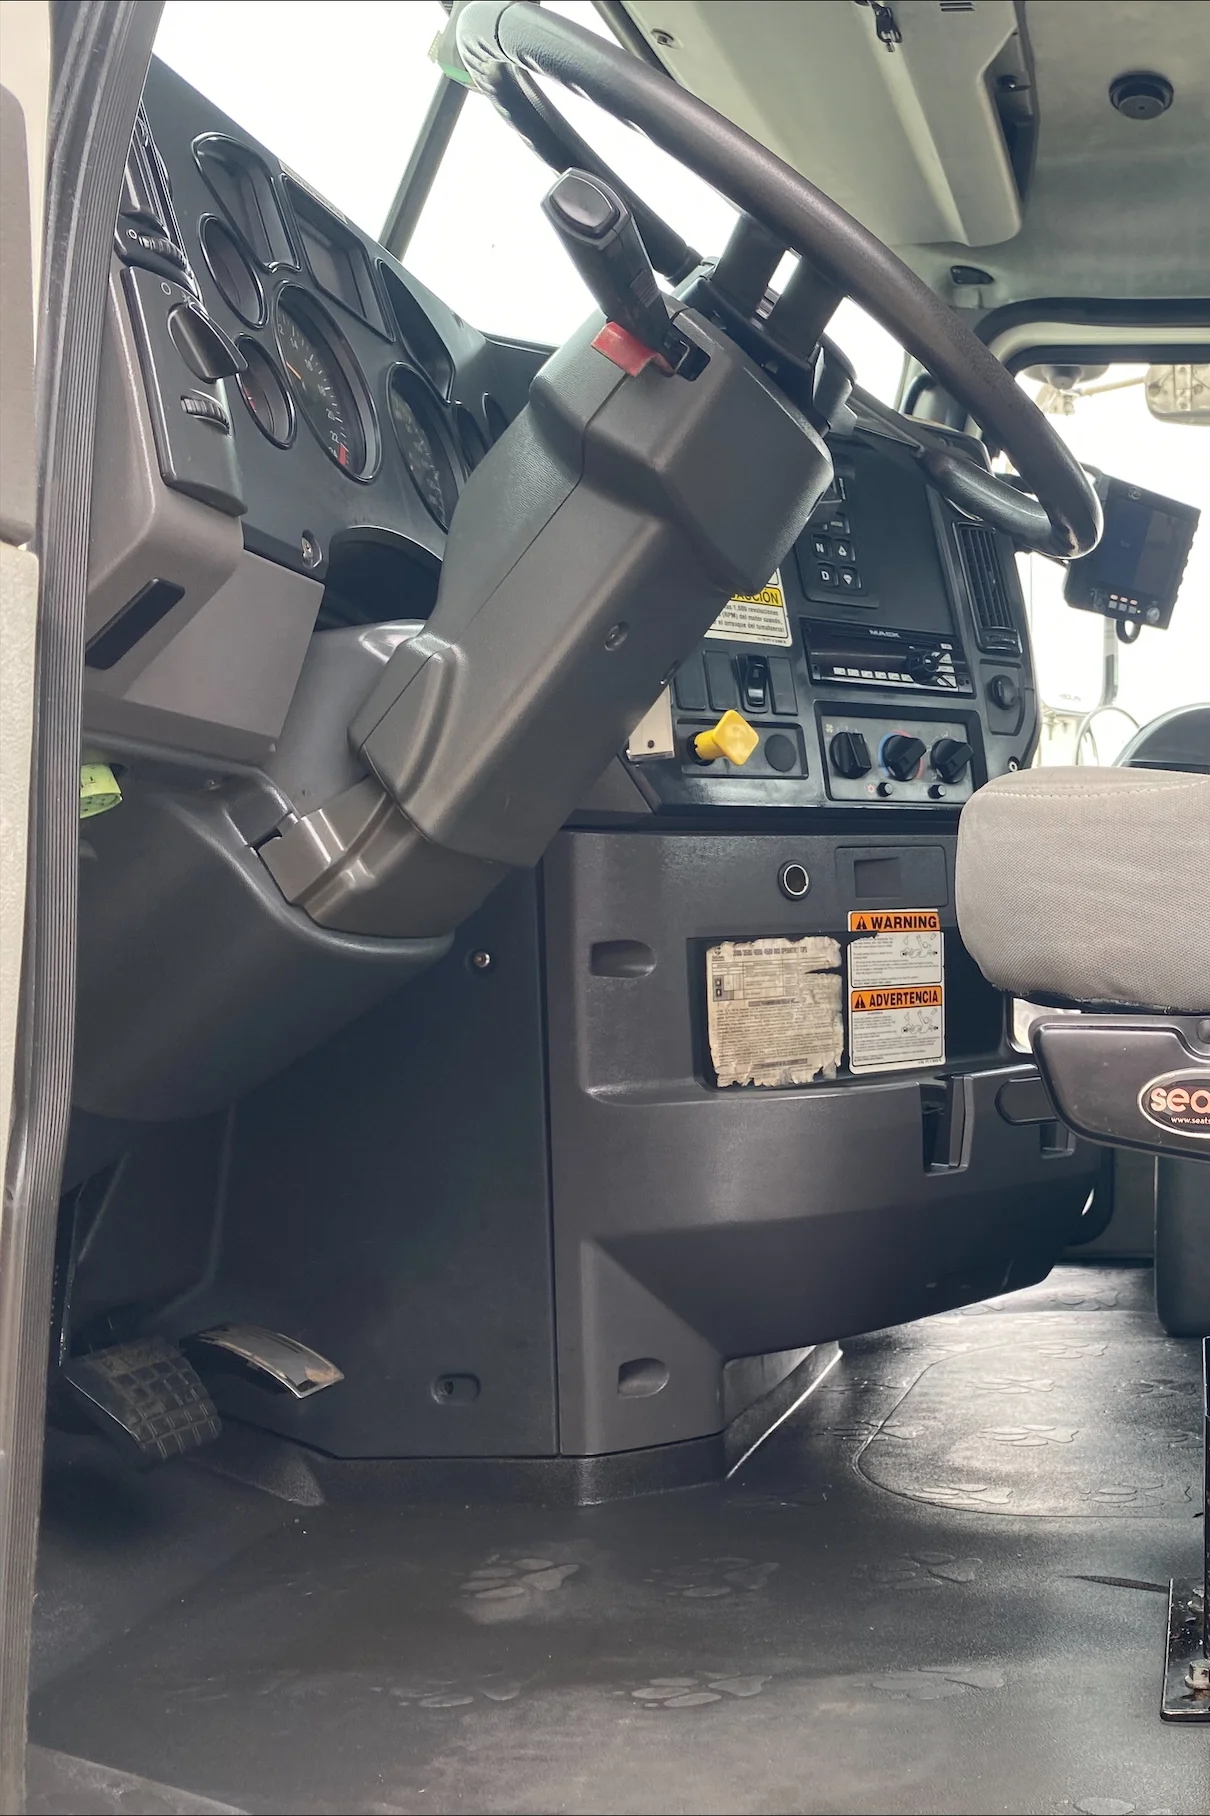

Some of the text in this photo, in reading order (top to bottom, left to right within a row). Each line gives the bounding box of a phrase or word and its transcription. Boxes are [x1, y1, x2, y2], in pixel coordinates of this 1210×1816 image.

[815, 542, 824, 553] N
[821, 570, 830, 581] D
[870, 915, 938, 930] WARNING
[869, 991, 939, 1007] ADVERTENCIA
